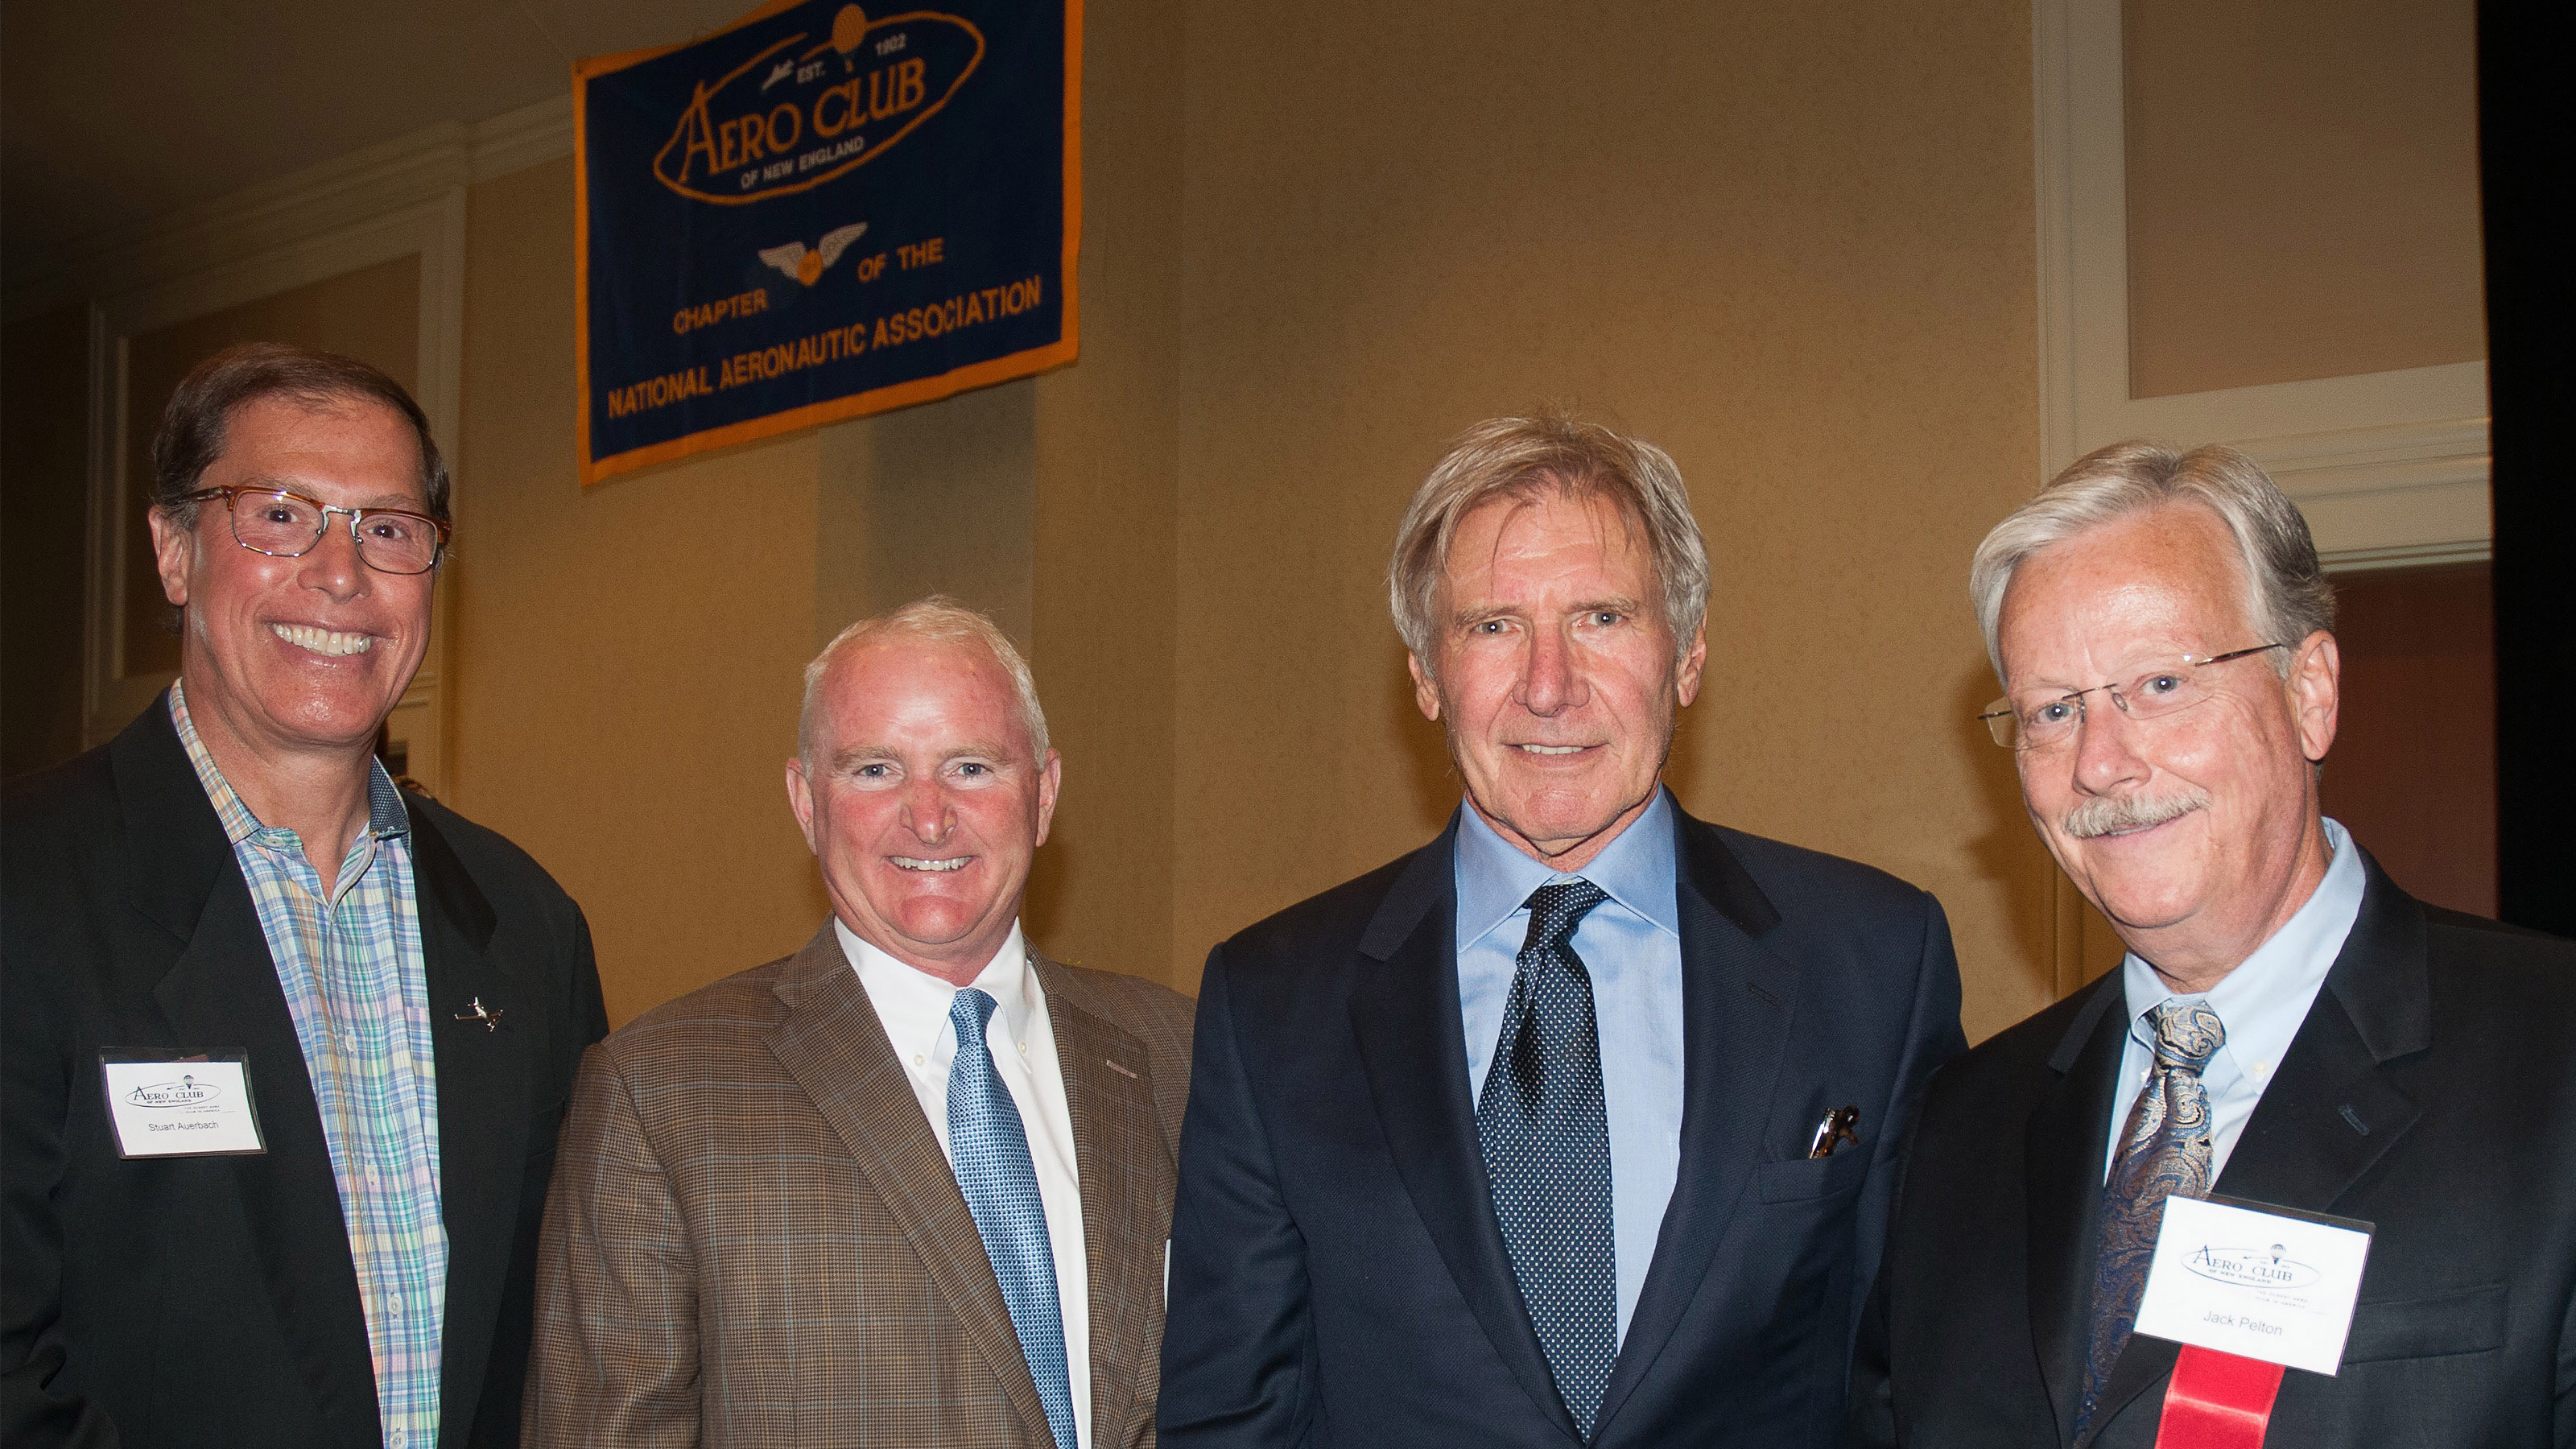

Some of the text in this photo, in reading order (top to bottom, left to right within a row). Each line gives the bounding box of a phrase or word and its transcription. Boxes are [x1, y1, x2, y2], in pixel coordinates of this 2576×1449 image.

[795, 32, 908, 85] EST. 1902
[812, 56, 927, 138] CLUB
[741, 135, 865, 190] OF NEW ENGLAND
[673, 237, 944, 335] CHAPTER OF THE
[607, 275, 1043, 419] NATIONAL AERONAUTIC ASSOCIATION
[134, 1085, 204, 1101] AERO CLUB
[148, 1121, 220, 1132] Stuart Auerbach
[2192, 1244, 2293, 1282] AERO CLUB
[2203, 1311, 2283, 1336] Jack Pelton
